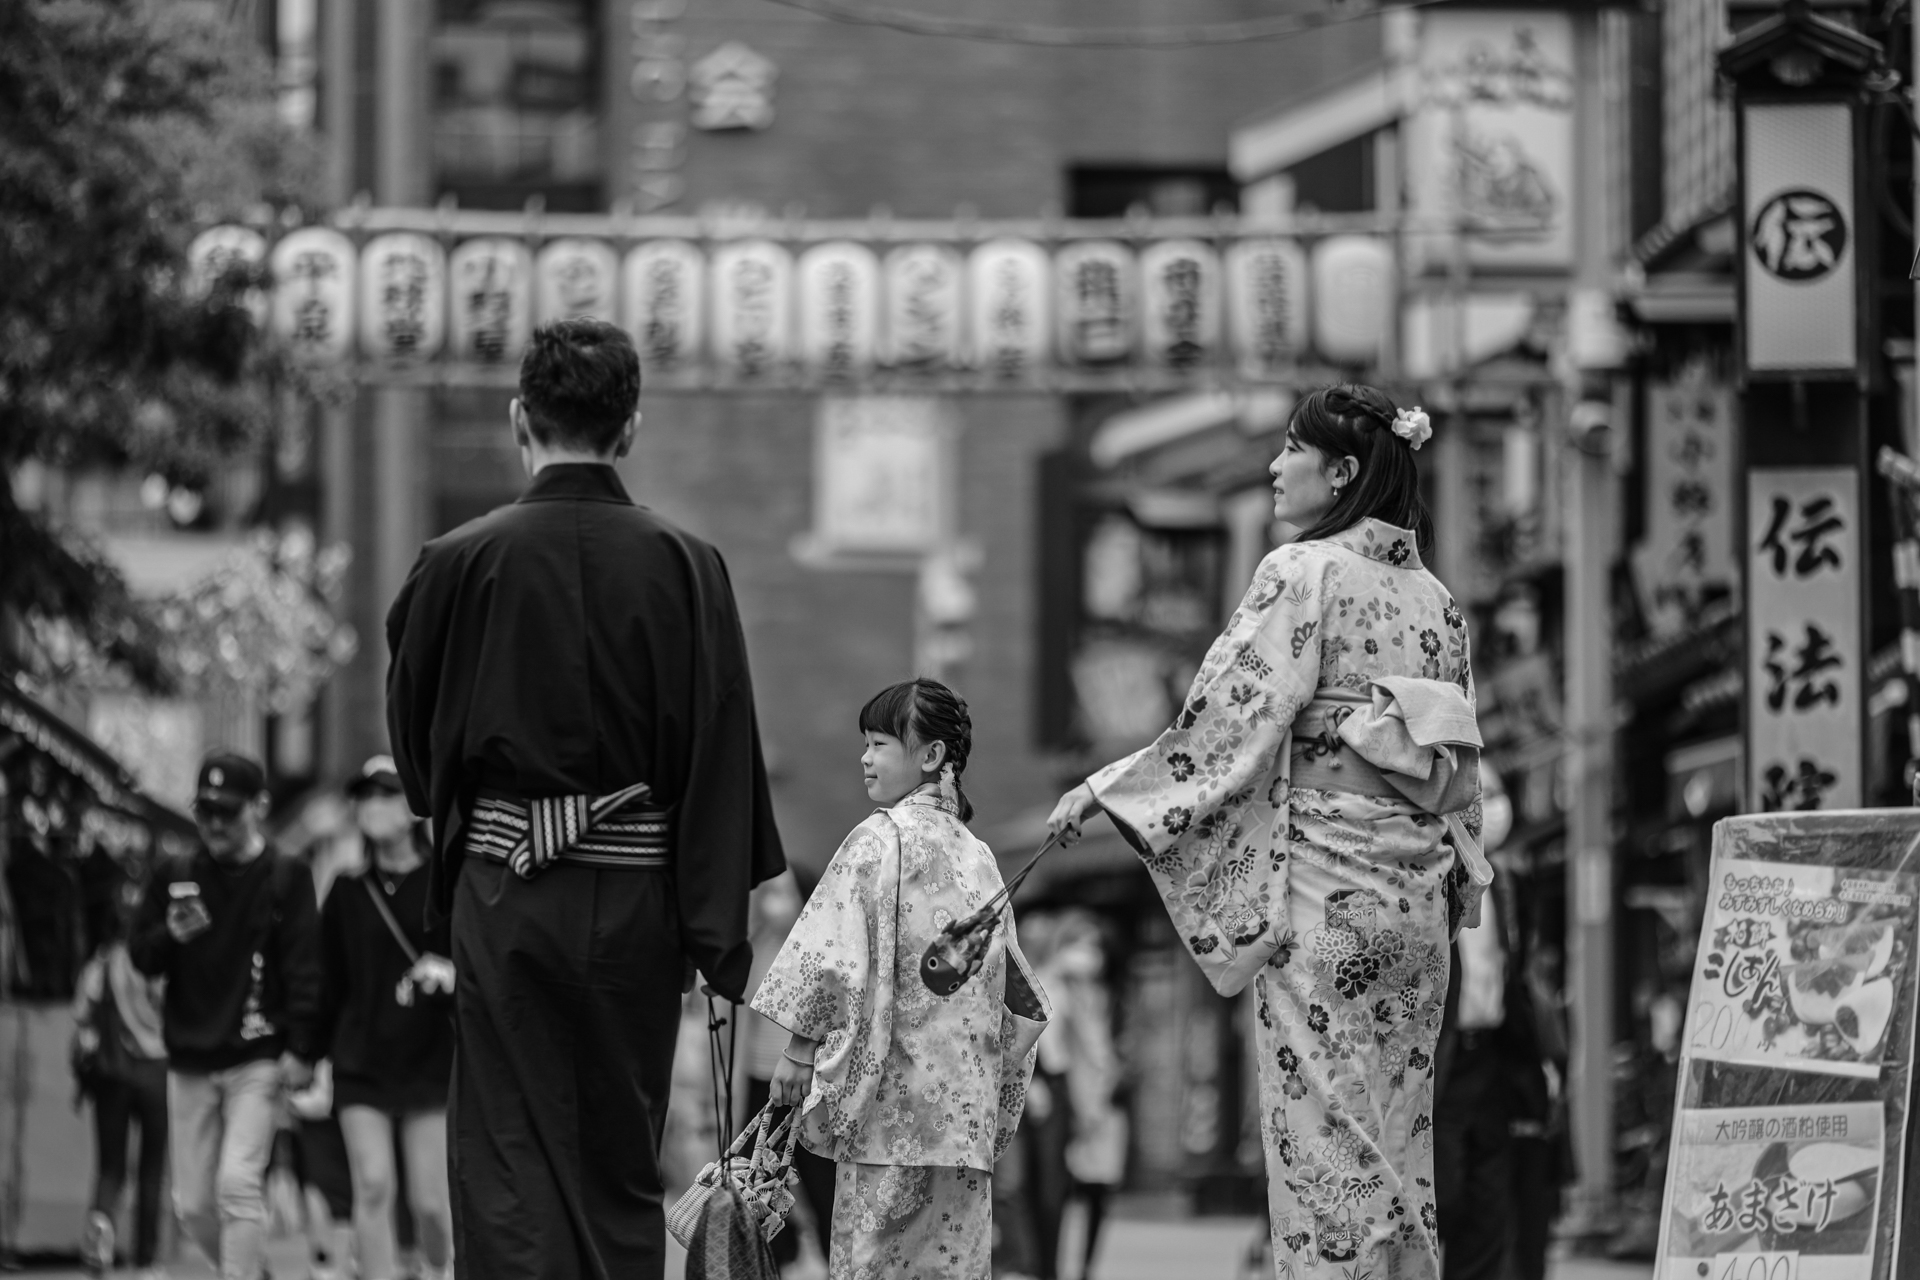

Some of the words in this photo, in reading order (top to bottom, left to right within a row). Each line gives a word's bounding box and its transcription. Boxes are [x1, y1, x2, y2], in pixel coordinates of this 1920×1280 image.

[1755, 197, 1837, 273] 伝
[1715, 1115, 1848, 1141] 大吟醸の酒粕使用
[1704, 1177, 1838, 1232] あまざけ
